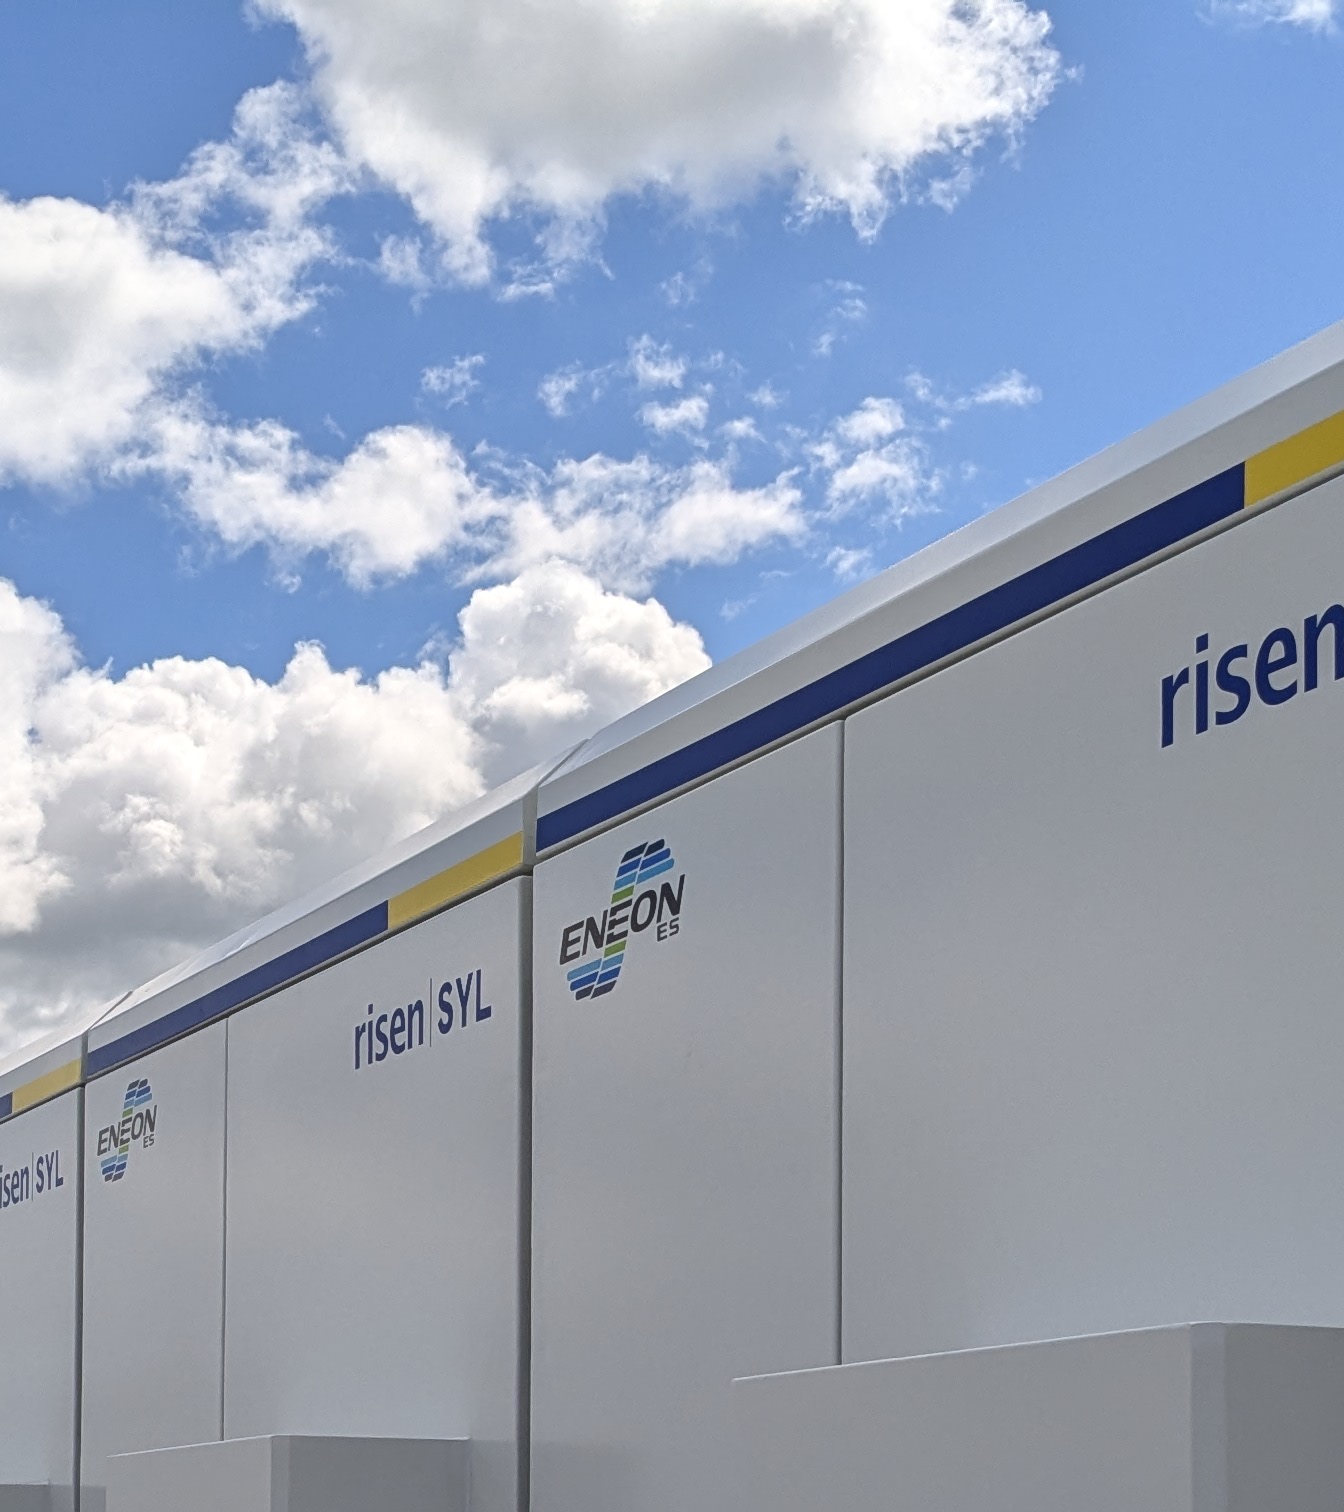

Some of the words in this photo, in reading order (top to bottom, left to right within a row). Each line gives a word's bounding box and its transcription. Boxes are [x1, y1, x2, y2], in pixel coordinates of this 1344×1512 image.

[559, 873, 686, 965] ENEON
[656, 917, 680, 942] ES
[354, 999, 424, 1070] risen
[437, 968, 492, 1035] SYL
[96, 1104, 158, 1157] ENEON
[142, 1133, 155, 1148] ES
[35, 1150, 64, 1194] SYL
